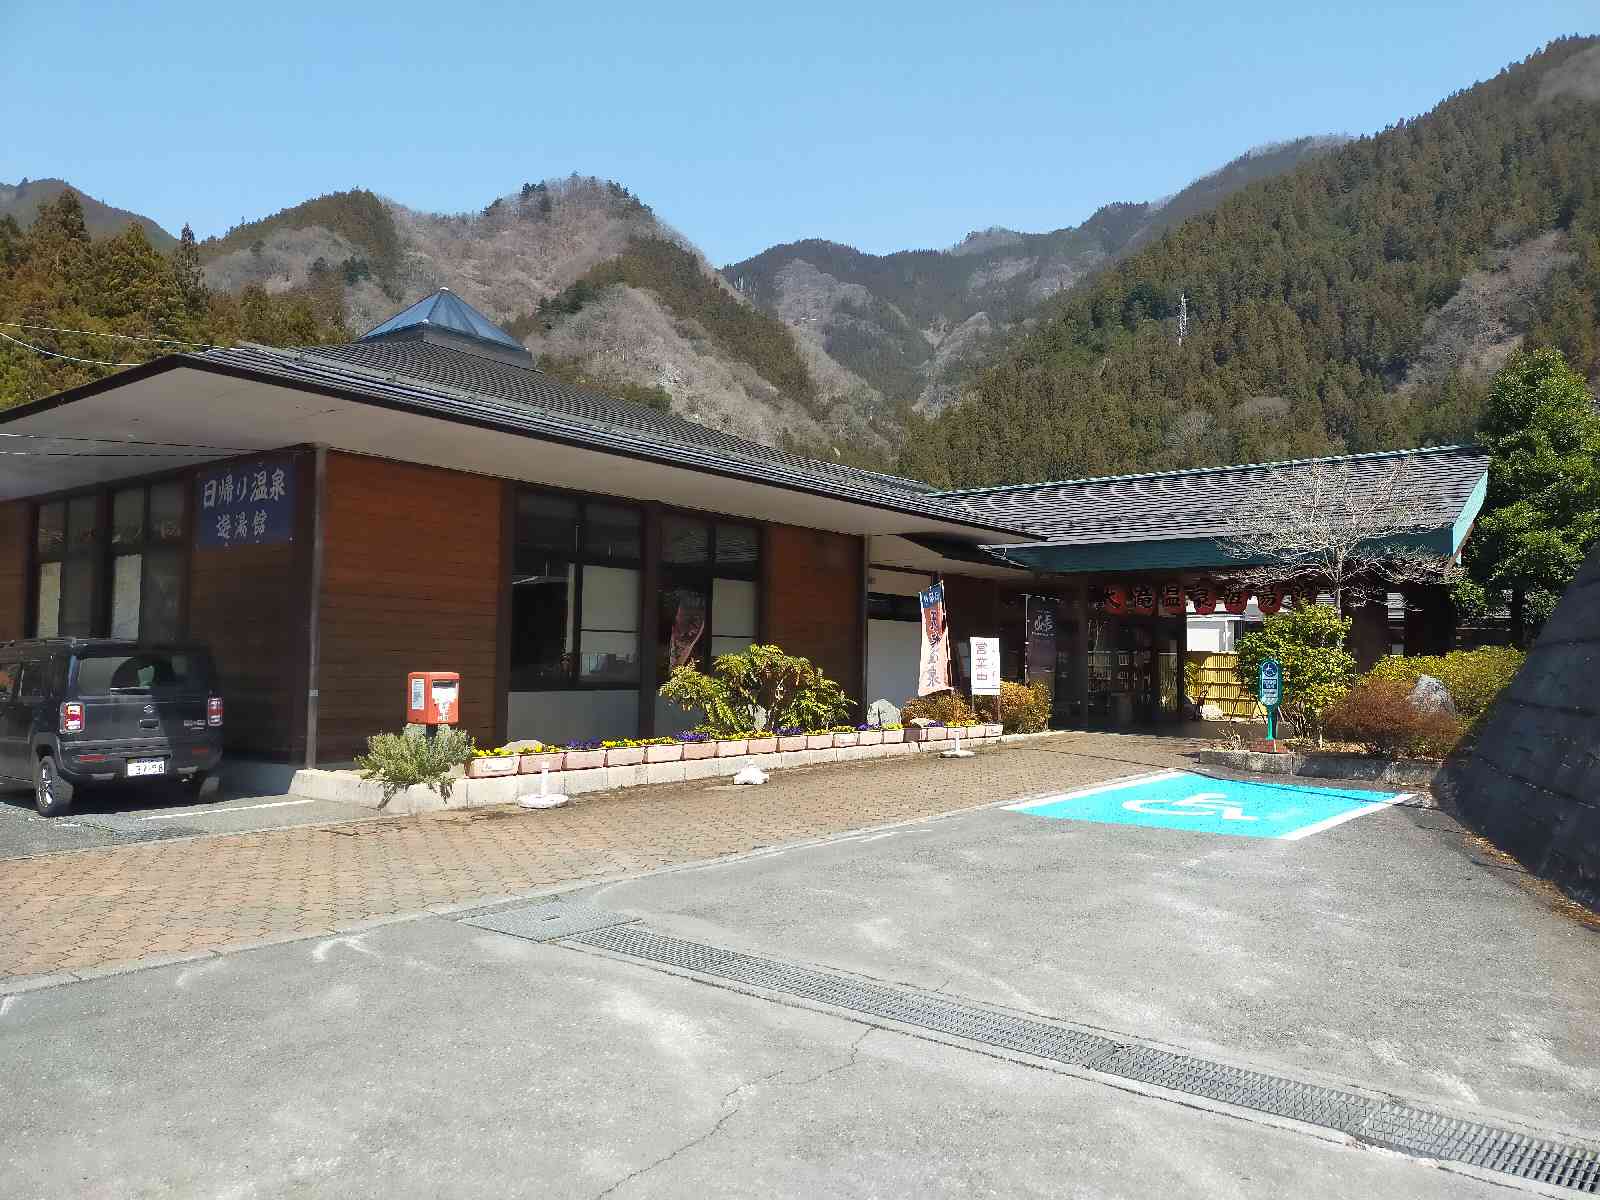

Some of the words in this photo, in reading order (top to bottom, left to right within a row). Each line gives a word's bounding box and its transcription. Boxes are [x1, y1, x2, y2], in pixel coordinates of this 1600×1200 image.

[202, 467, 286, 510] 日帰り温泉
[975, 639, 988, 681] 営業中
